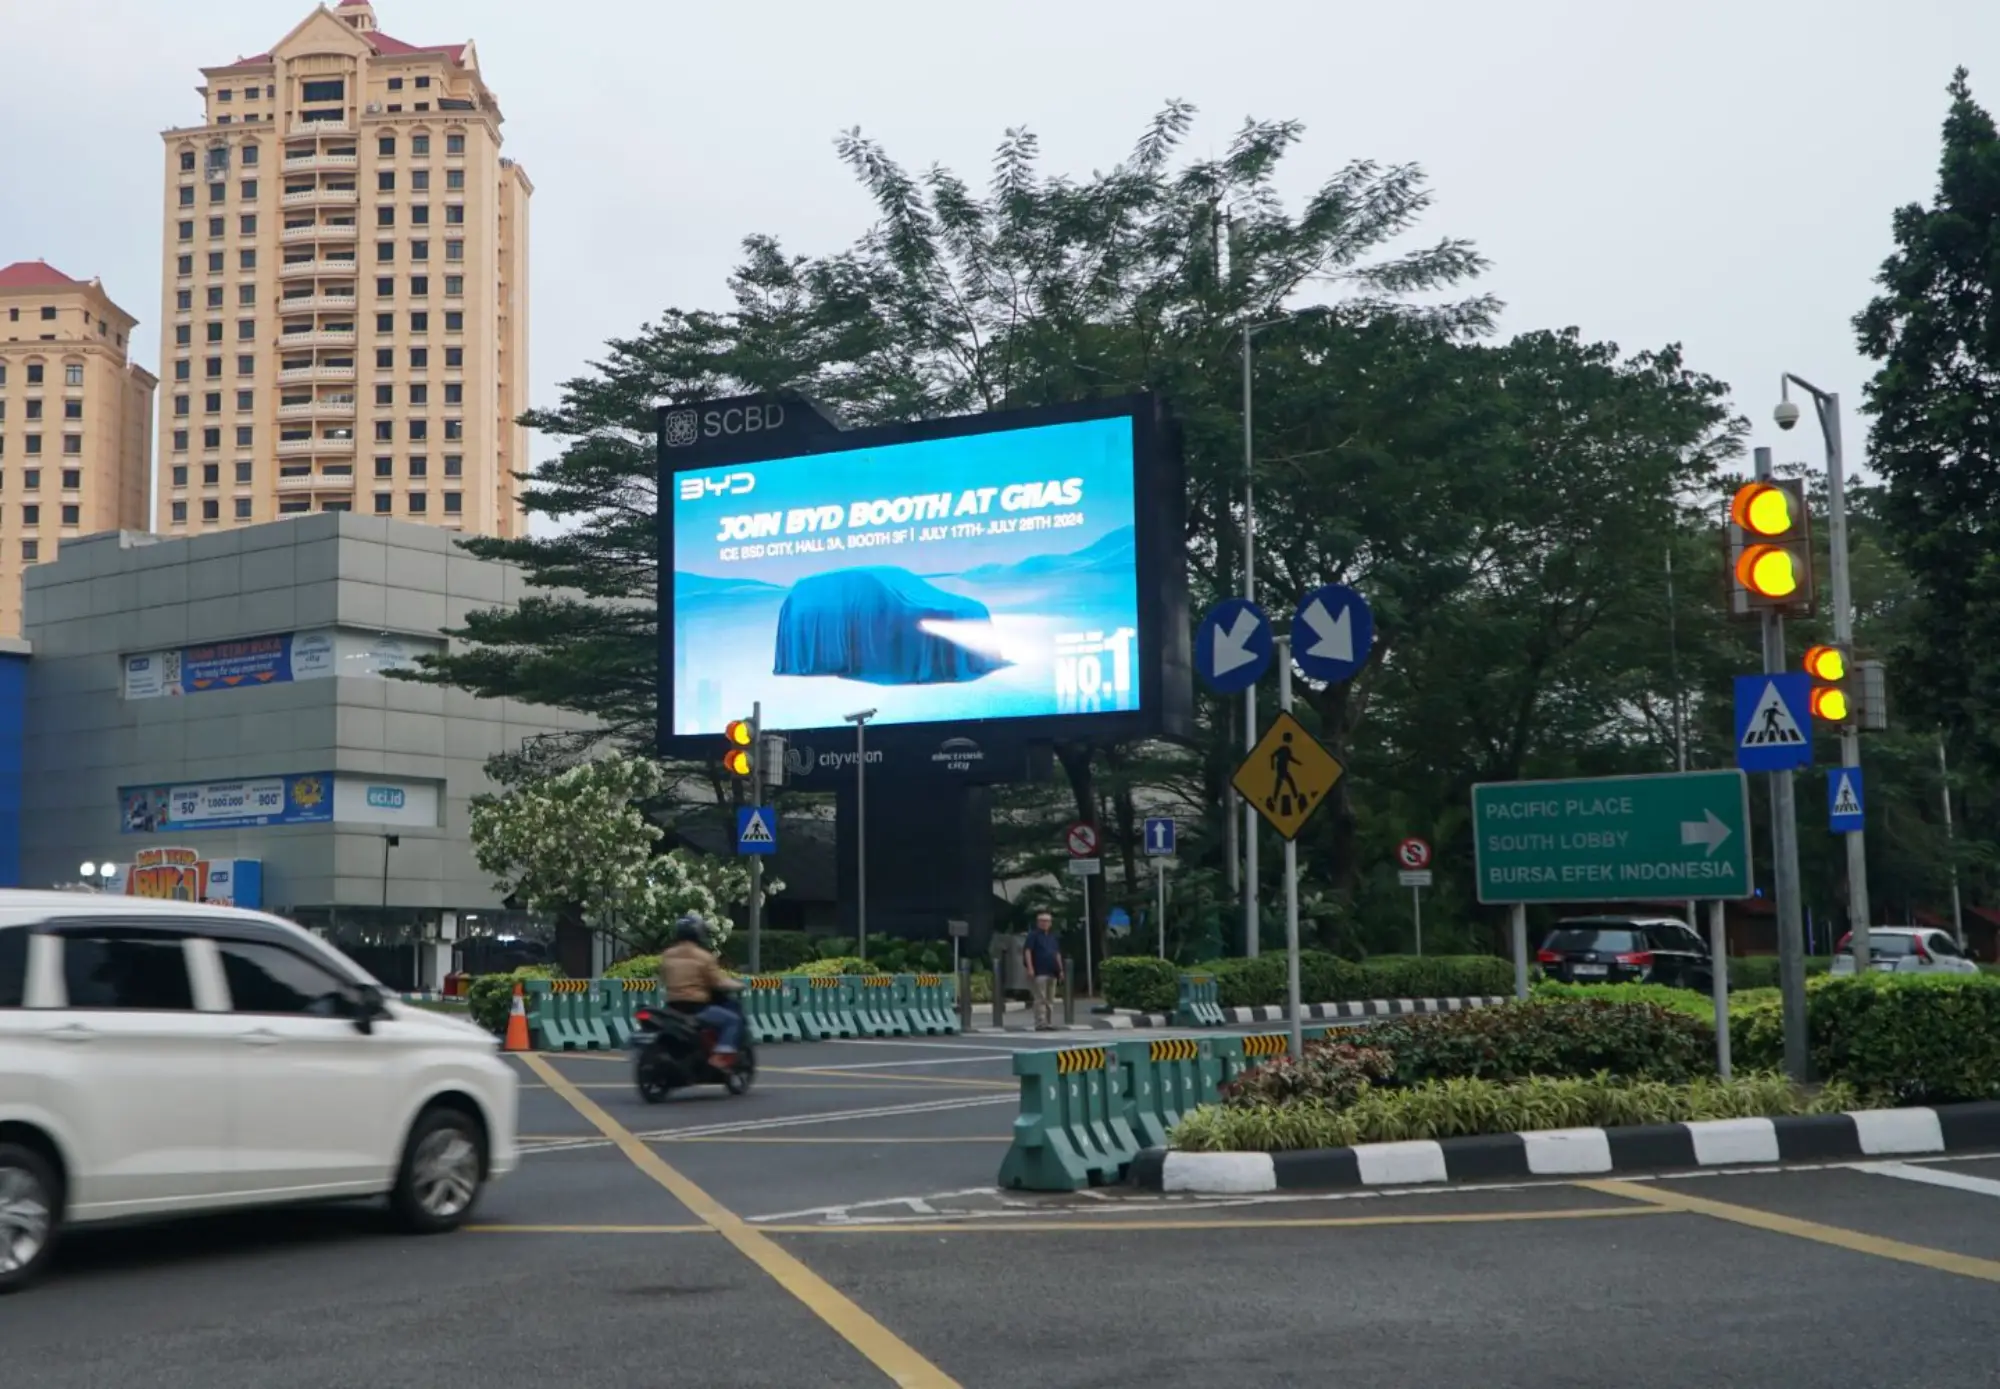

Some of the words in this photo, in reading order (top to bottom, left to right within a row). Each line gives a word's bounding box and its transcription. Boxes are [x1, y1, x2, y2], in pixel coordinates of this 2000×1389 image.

[704, 403, 785, 437] SCBD
[680, 471, 755, 500] BYD
[716, 511, 782, 542] JOIN
[786, 505, 844, 534] BYD
[848, 492, 952, 527] BOOTH
[954, 486, 998, 517] AT
[719, 547, 740, 562] ICE
[741, 545, 765, 560] BSD
[794, 538, 825, 554] HALL
[847, 530, 891, 548] BOOTH
[918, 525, 948, 542] JULY
[986, 520, 1017, 535] JULY
[1053, 512, 1084, 528] 2024
[819, 750, 883, 770] cityvison
[369, 788, 402, 806] eci.id
[1485, 801, 1559, 819] PACIFIC
[1565, 797, 1634, 815] PLACE
[1488, 834, 1554, 851] SOUTH
[1561, 831, 1629, 850] LOBBY
[1490, 866, 1557, 884] BURSA
[1562, 864, 1614, 882] EFEK
[1620, 860, 1735, 881] INDONESIA
